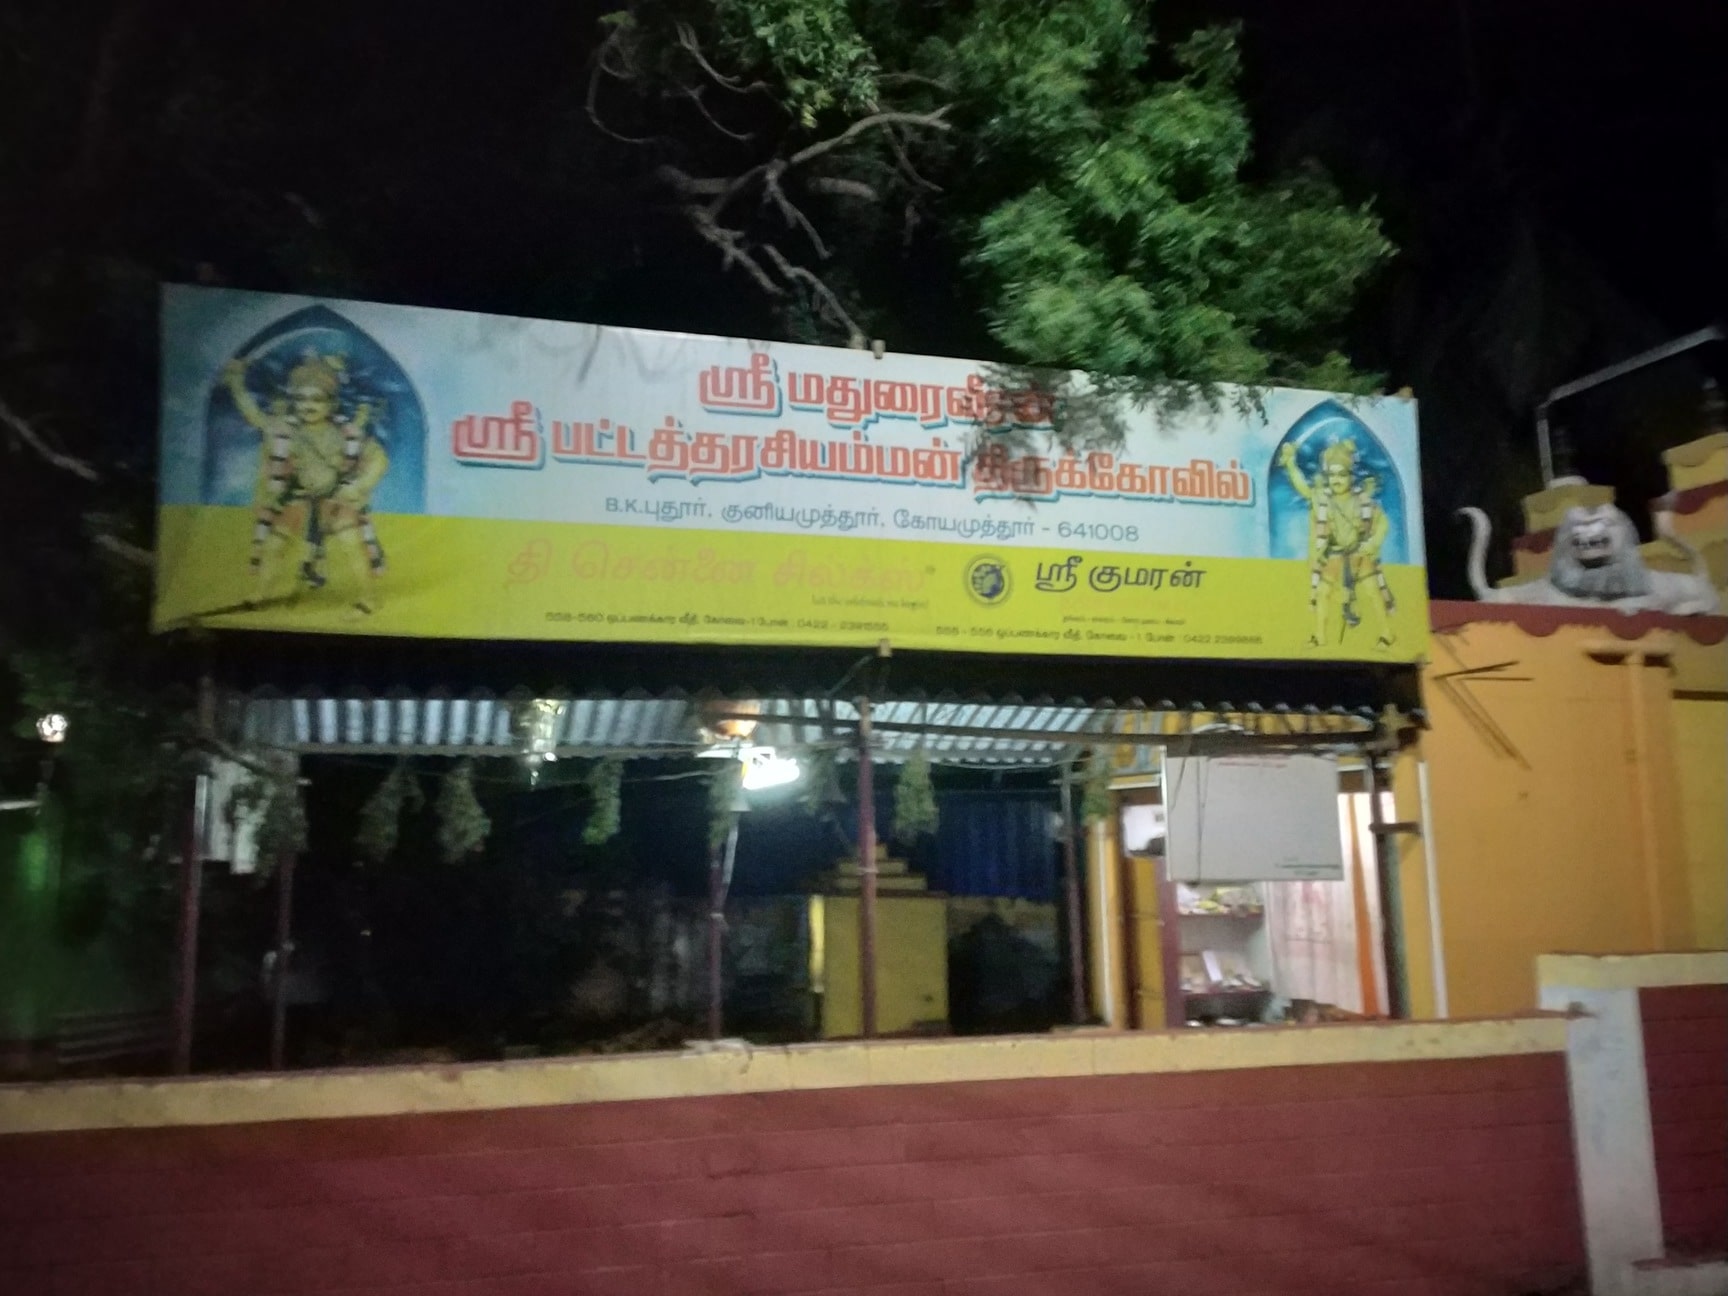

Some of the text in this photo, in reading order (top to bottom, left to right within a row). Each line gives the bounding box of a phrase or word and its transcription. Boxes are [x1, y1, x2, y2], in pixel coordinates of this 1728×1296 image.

[700, 352, 780, 415] ஸ்ரீ
[452, 400, 1254, 504] ஸ்ரீ பட்டத்தரசியம்மன் திருக்கோவில்
[893, 509, 1035, 541] கோயமுத்தூர்
[1058, 520, 1140, 543] 641008
[1035, 555, 1206, 592] ஸ்ரீ குமரன்
